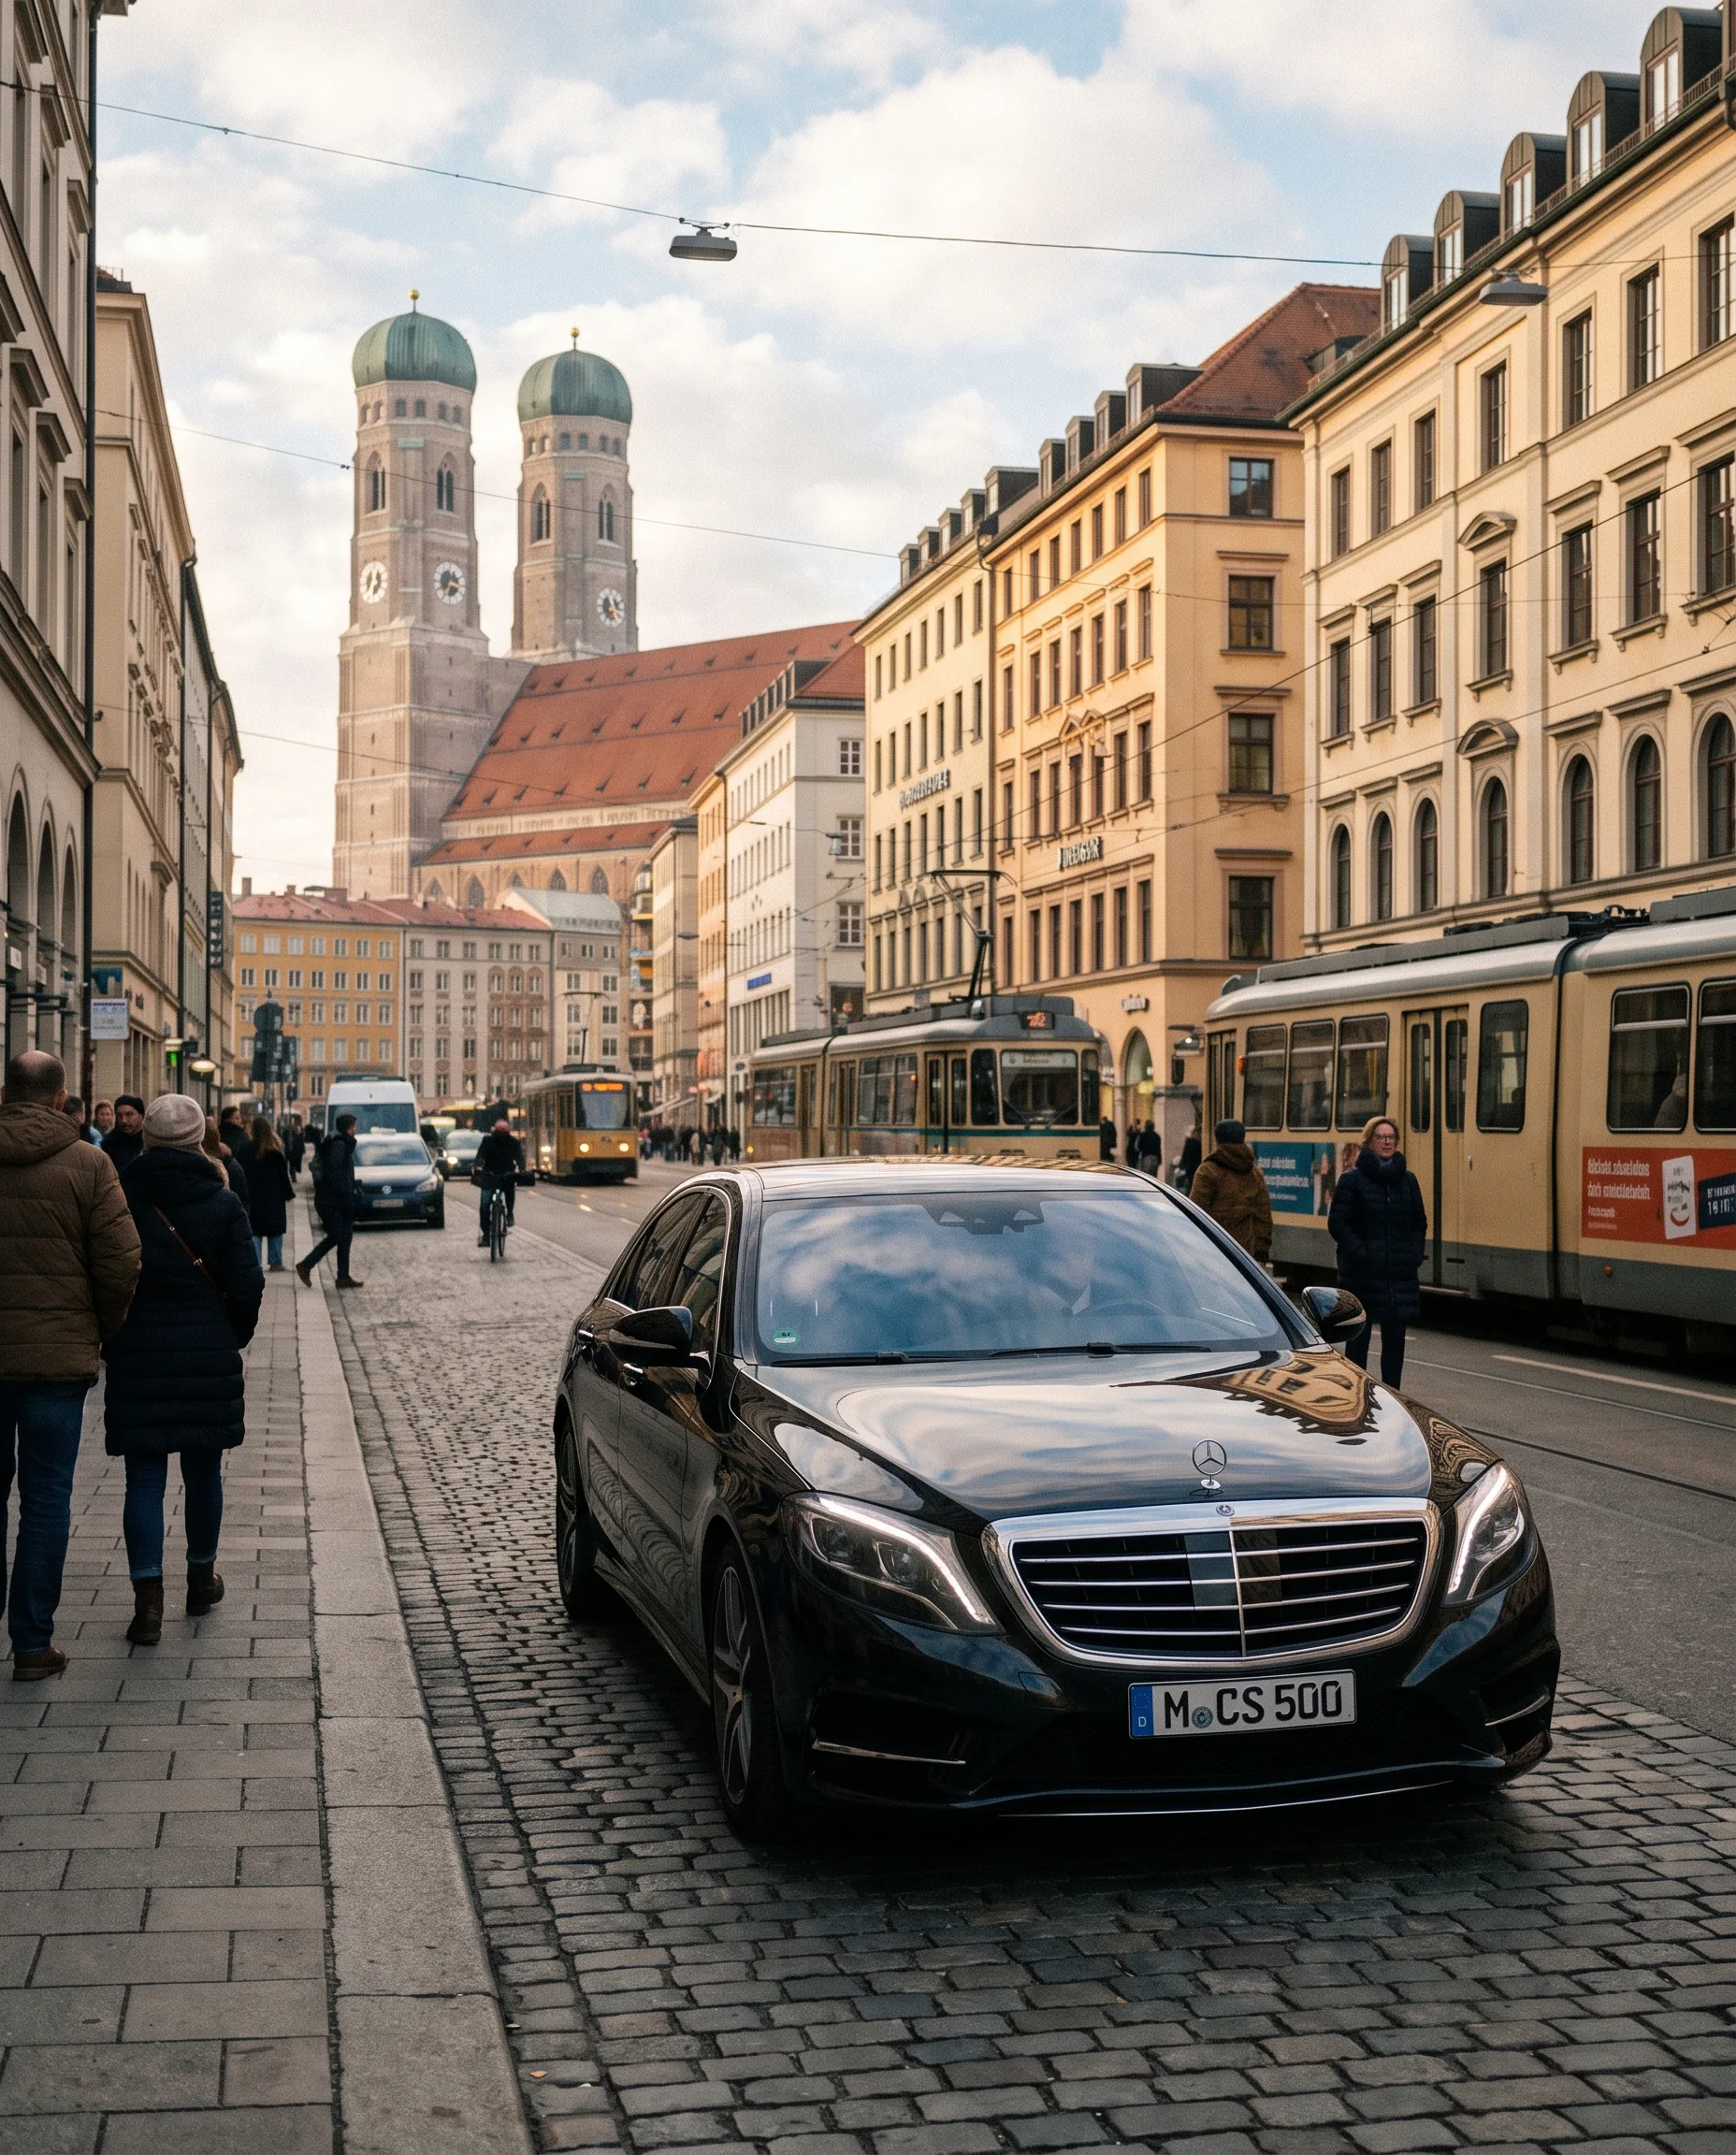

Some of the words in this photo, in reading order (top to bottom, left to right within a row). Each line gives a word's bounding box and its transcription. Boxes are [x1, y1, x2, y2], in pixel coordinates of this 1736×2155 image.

[1164, 1690, 1190, 1728] M
[1216, 1685, 1265, 1726] CS
[1275, 1680, 1342, 1721] 500
[1138, 1716, 1147, 1728] D
